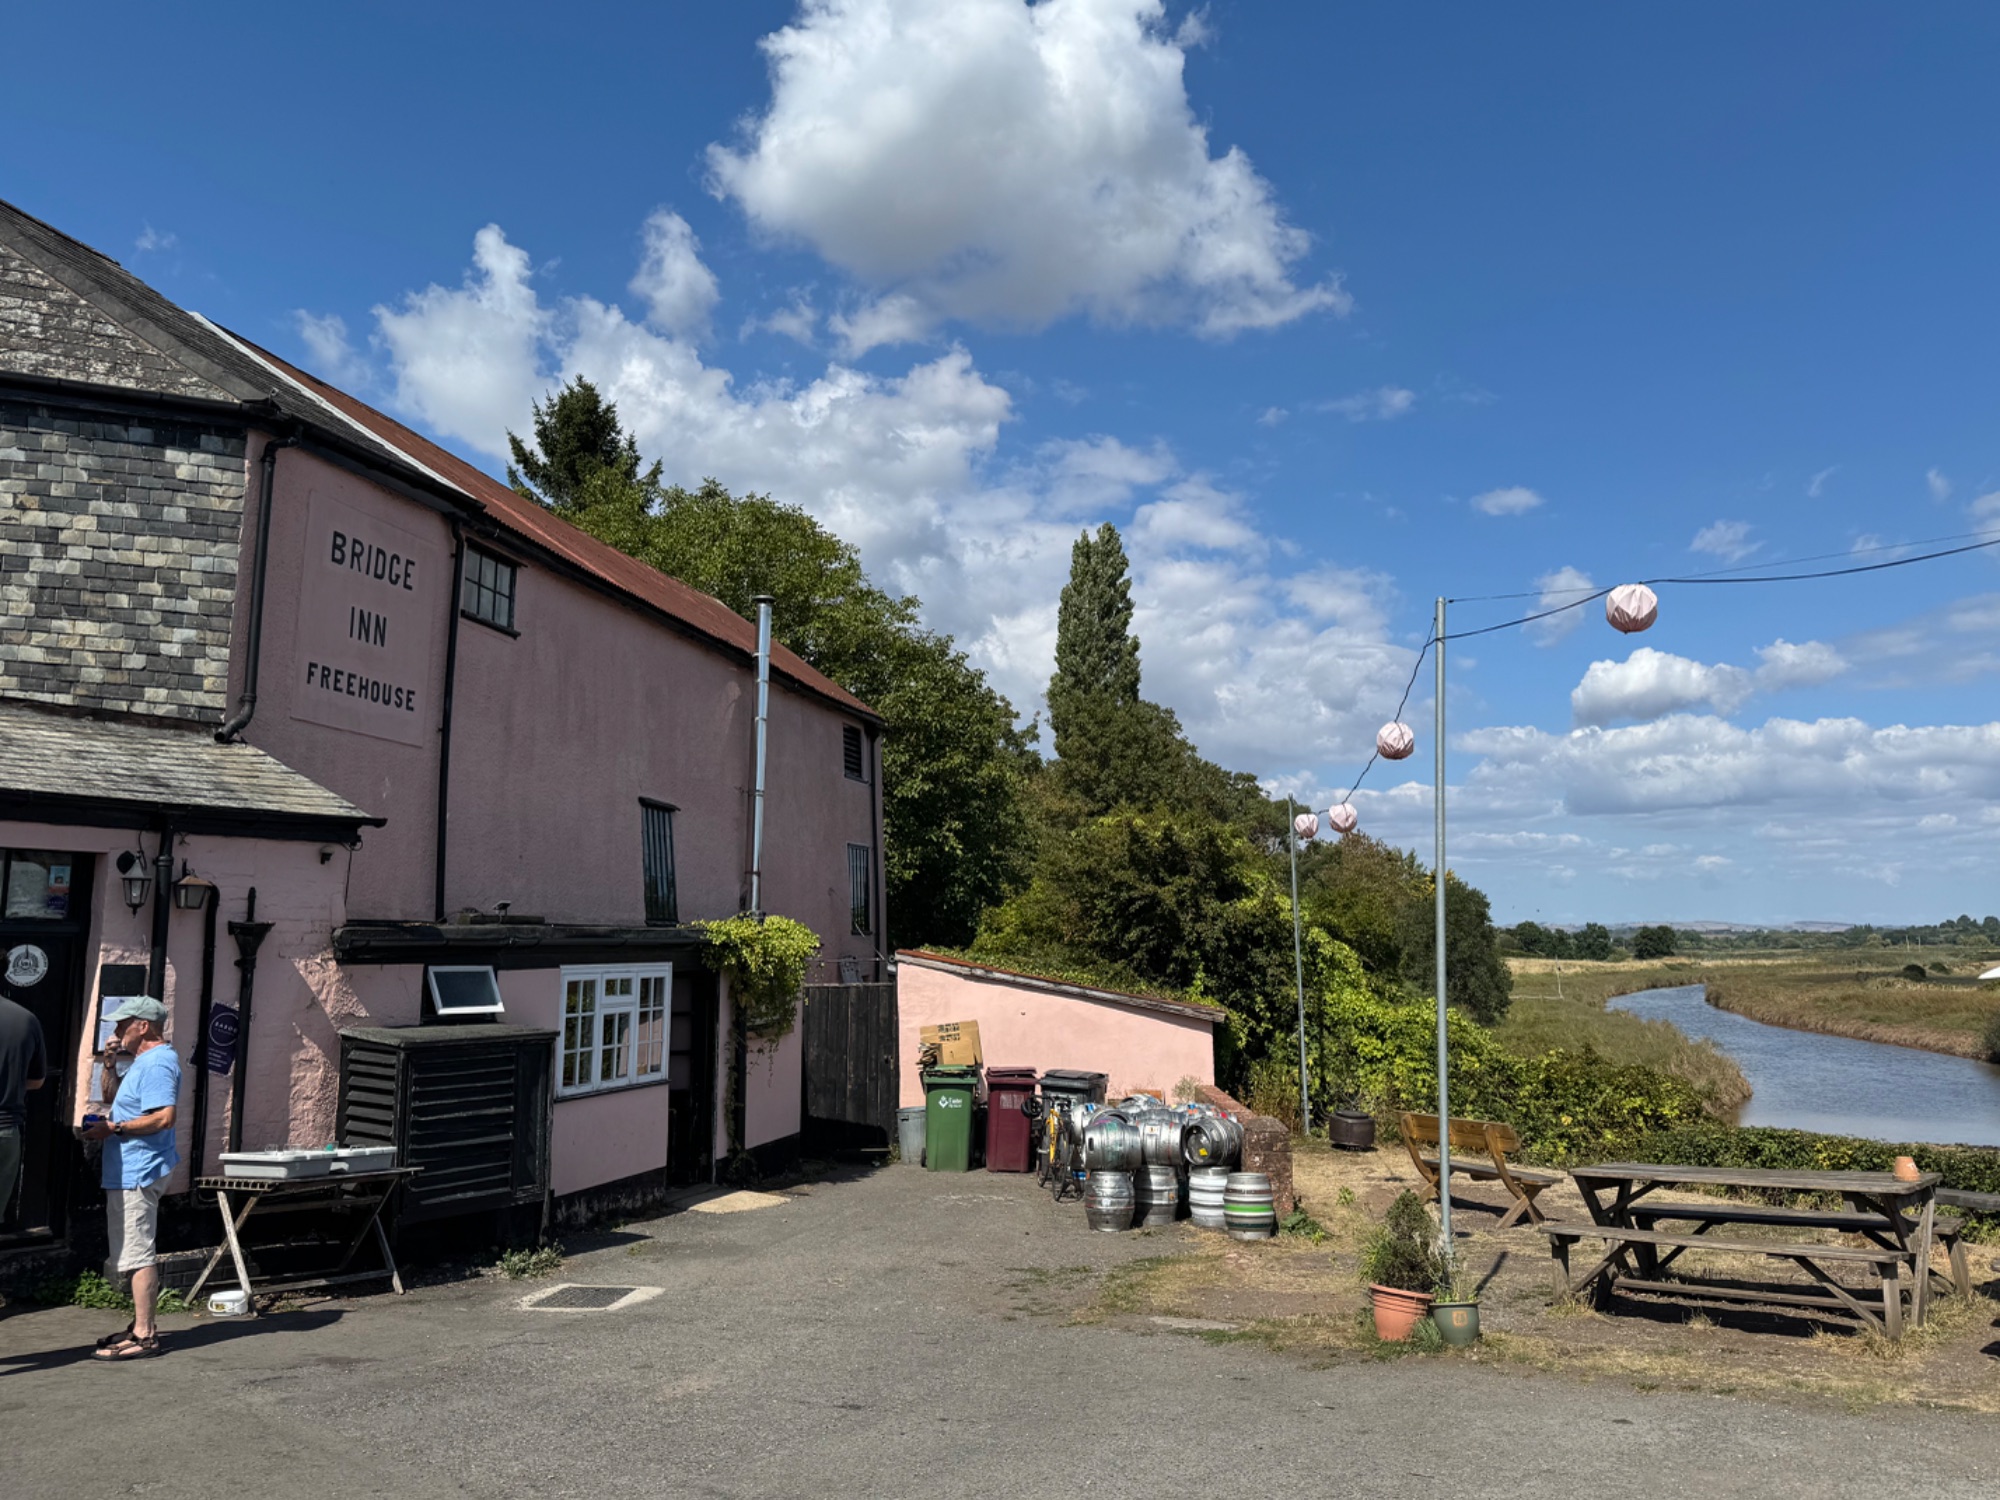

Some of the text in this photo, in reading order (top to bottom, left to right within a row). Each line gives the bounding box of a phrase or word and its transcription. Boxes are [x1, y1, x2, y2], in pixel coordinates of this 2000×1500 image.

[331, 530, 415, 591] BRIDGE
[349, 606, 387, 648] INN
[306, 661, 415, 712] FREEHOUSE
